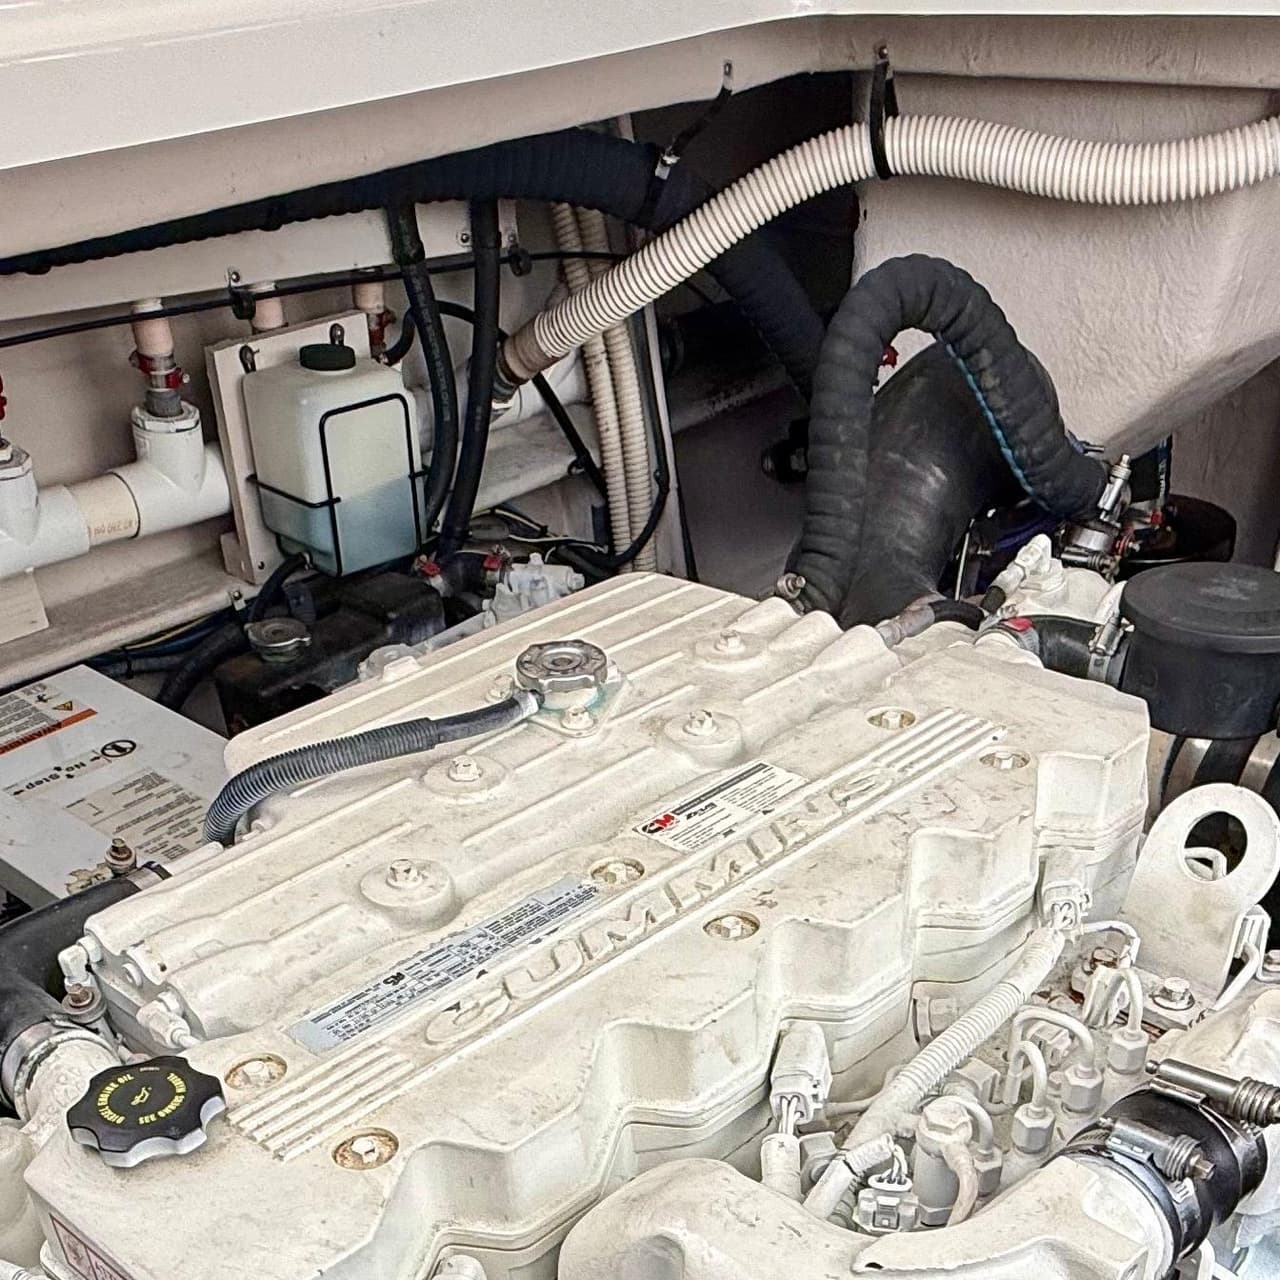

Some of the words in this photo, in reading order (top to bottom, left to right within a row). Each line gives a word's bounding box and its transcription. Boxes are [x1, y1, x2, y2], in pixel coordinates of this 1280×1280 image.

[65, 762, 87, 773] No
[25, 773, 61, 790] Step
[117, 1074, 134, 1084] OIL
